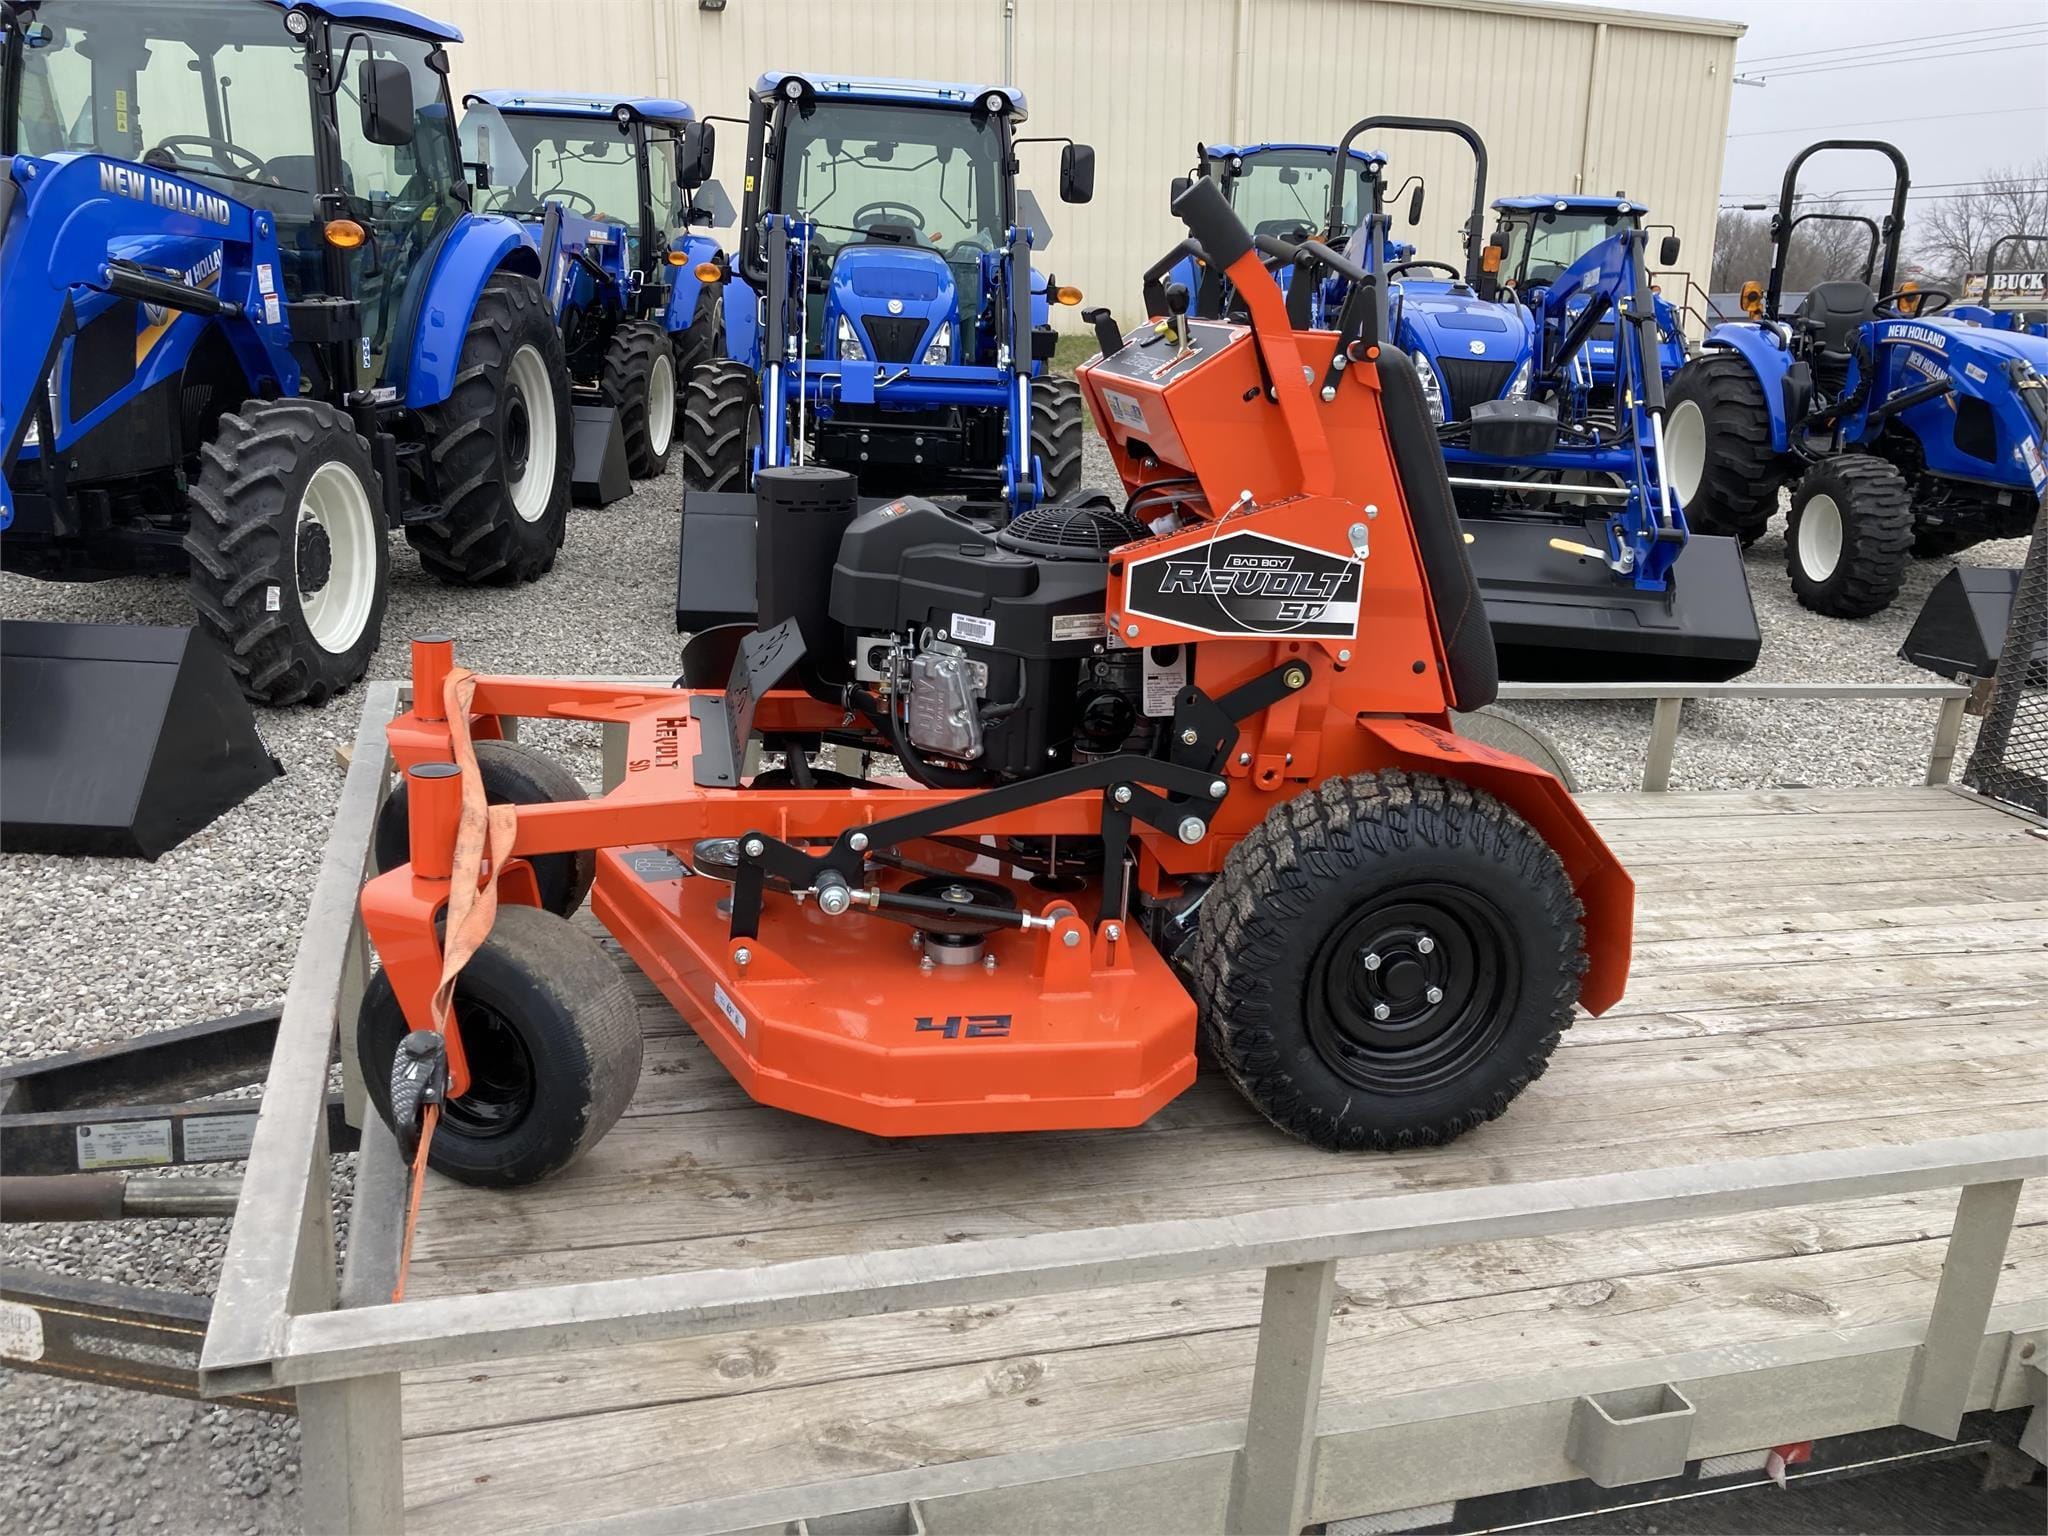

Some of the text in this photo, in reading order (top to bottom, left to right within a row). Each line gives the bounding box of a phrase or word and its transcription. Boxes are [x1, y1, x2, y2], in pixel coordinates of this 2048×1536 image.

[100, 162, 231, 226] NEW HOLLAND
[1993, 273, 2045, 290] BUCK
[1888, 324, 1946, 349] NEW HOLLAND
[1233, 558, 1287, 568] BAD BOY
[1158, 561, 1353, 598] REVOLT
[1276, 601, 1329, 621] SD
[653, 716, 687, 768] REVOLT
[914, 1014, 1013, 1039] 42
